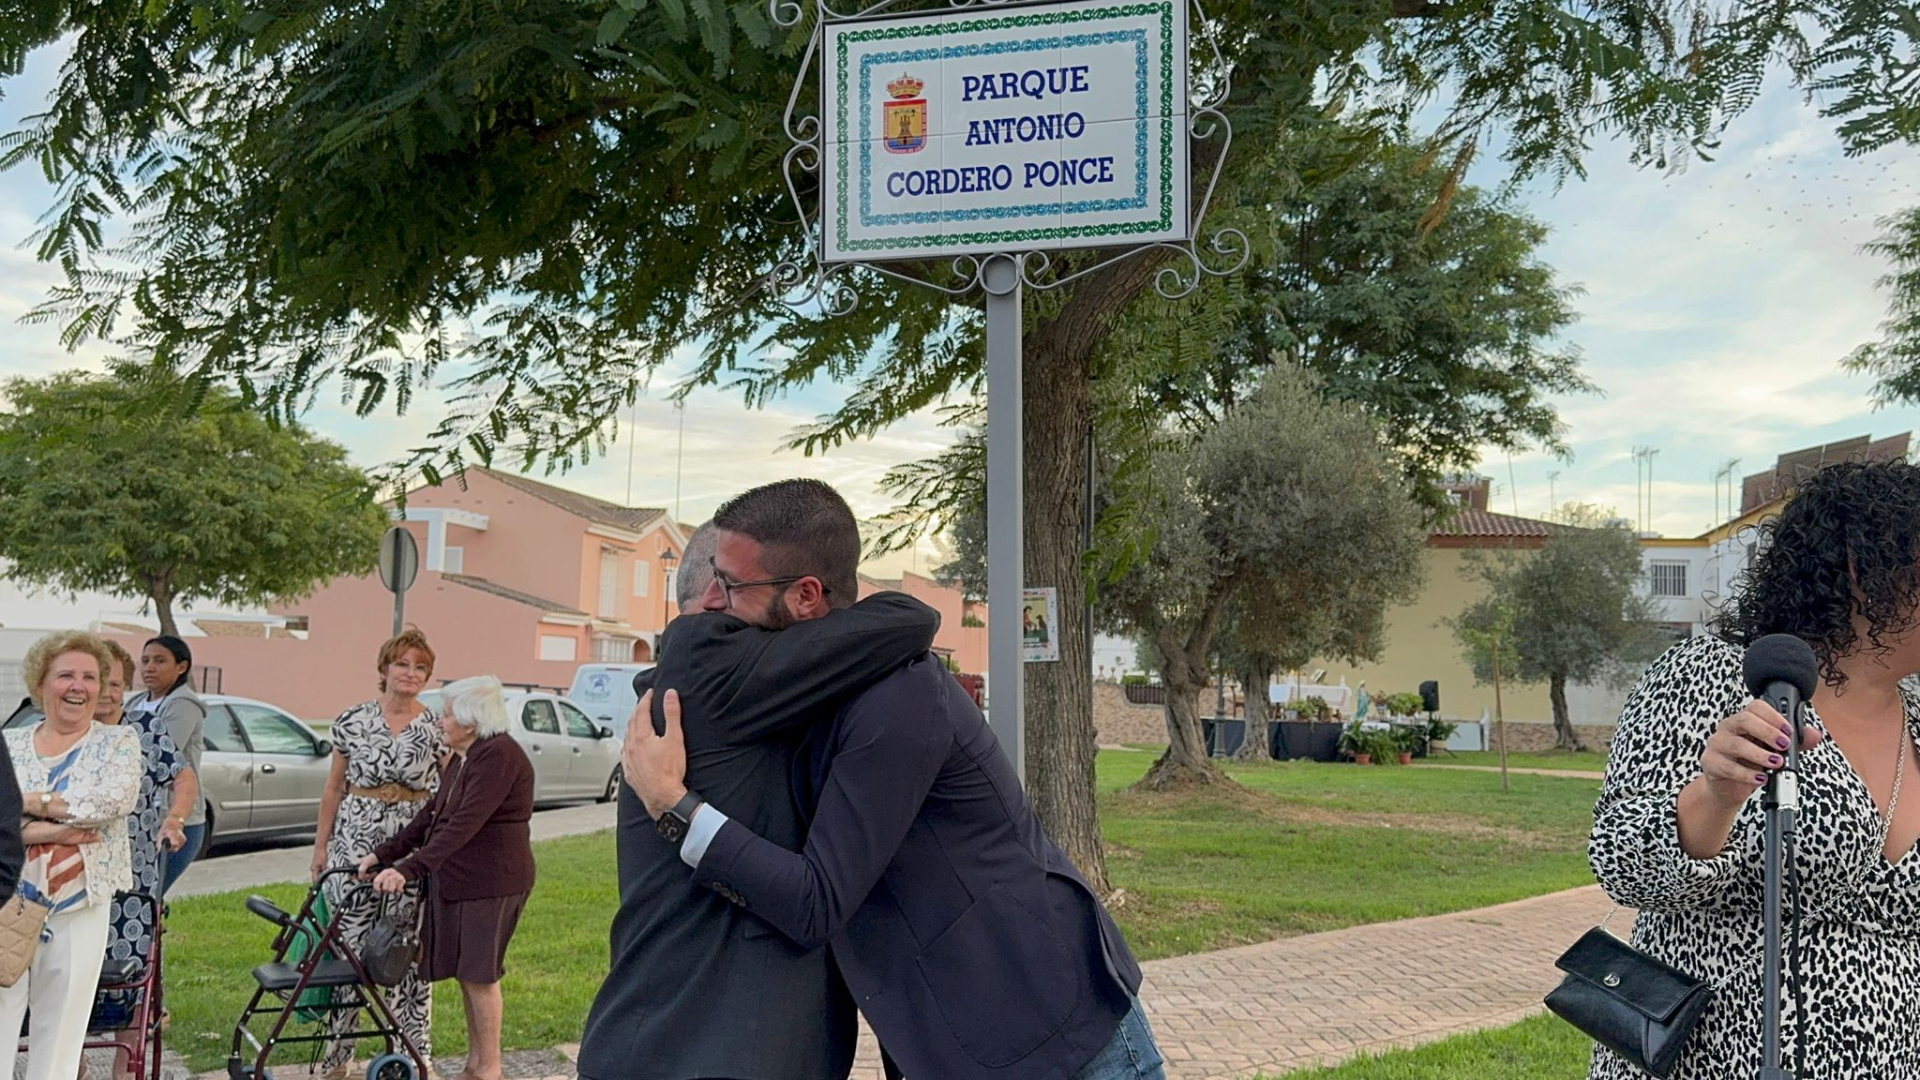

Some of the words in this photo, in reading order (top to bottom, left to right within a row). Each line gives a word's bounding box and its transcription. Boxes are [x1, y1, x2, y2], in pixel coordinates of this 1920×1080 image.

[962, 66, 1089, 101] PARQUE
[965, 112, 1086, 146] ANTONIO
[887, 165, 1013, 197] CORDERO
[1024, 157, 1115, 188] PONCE
